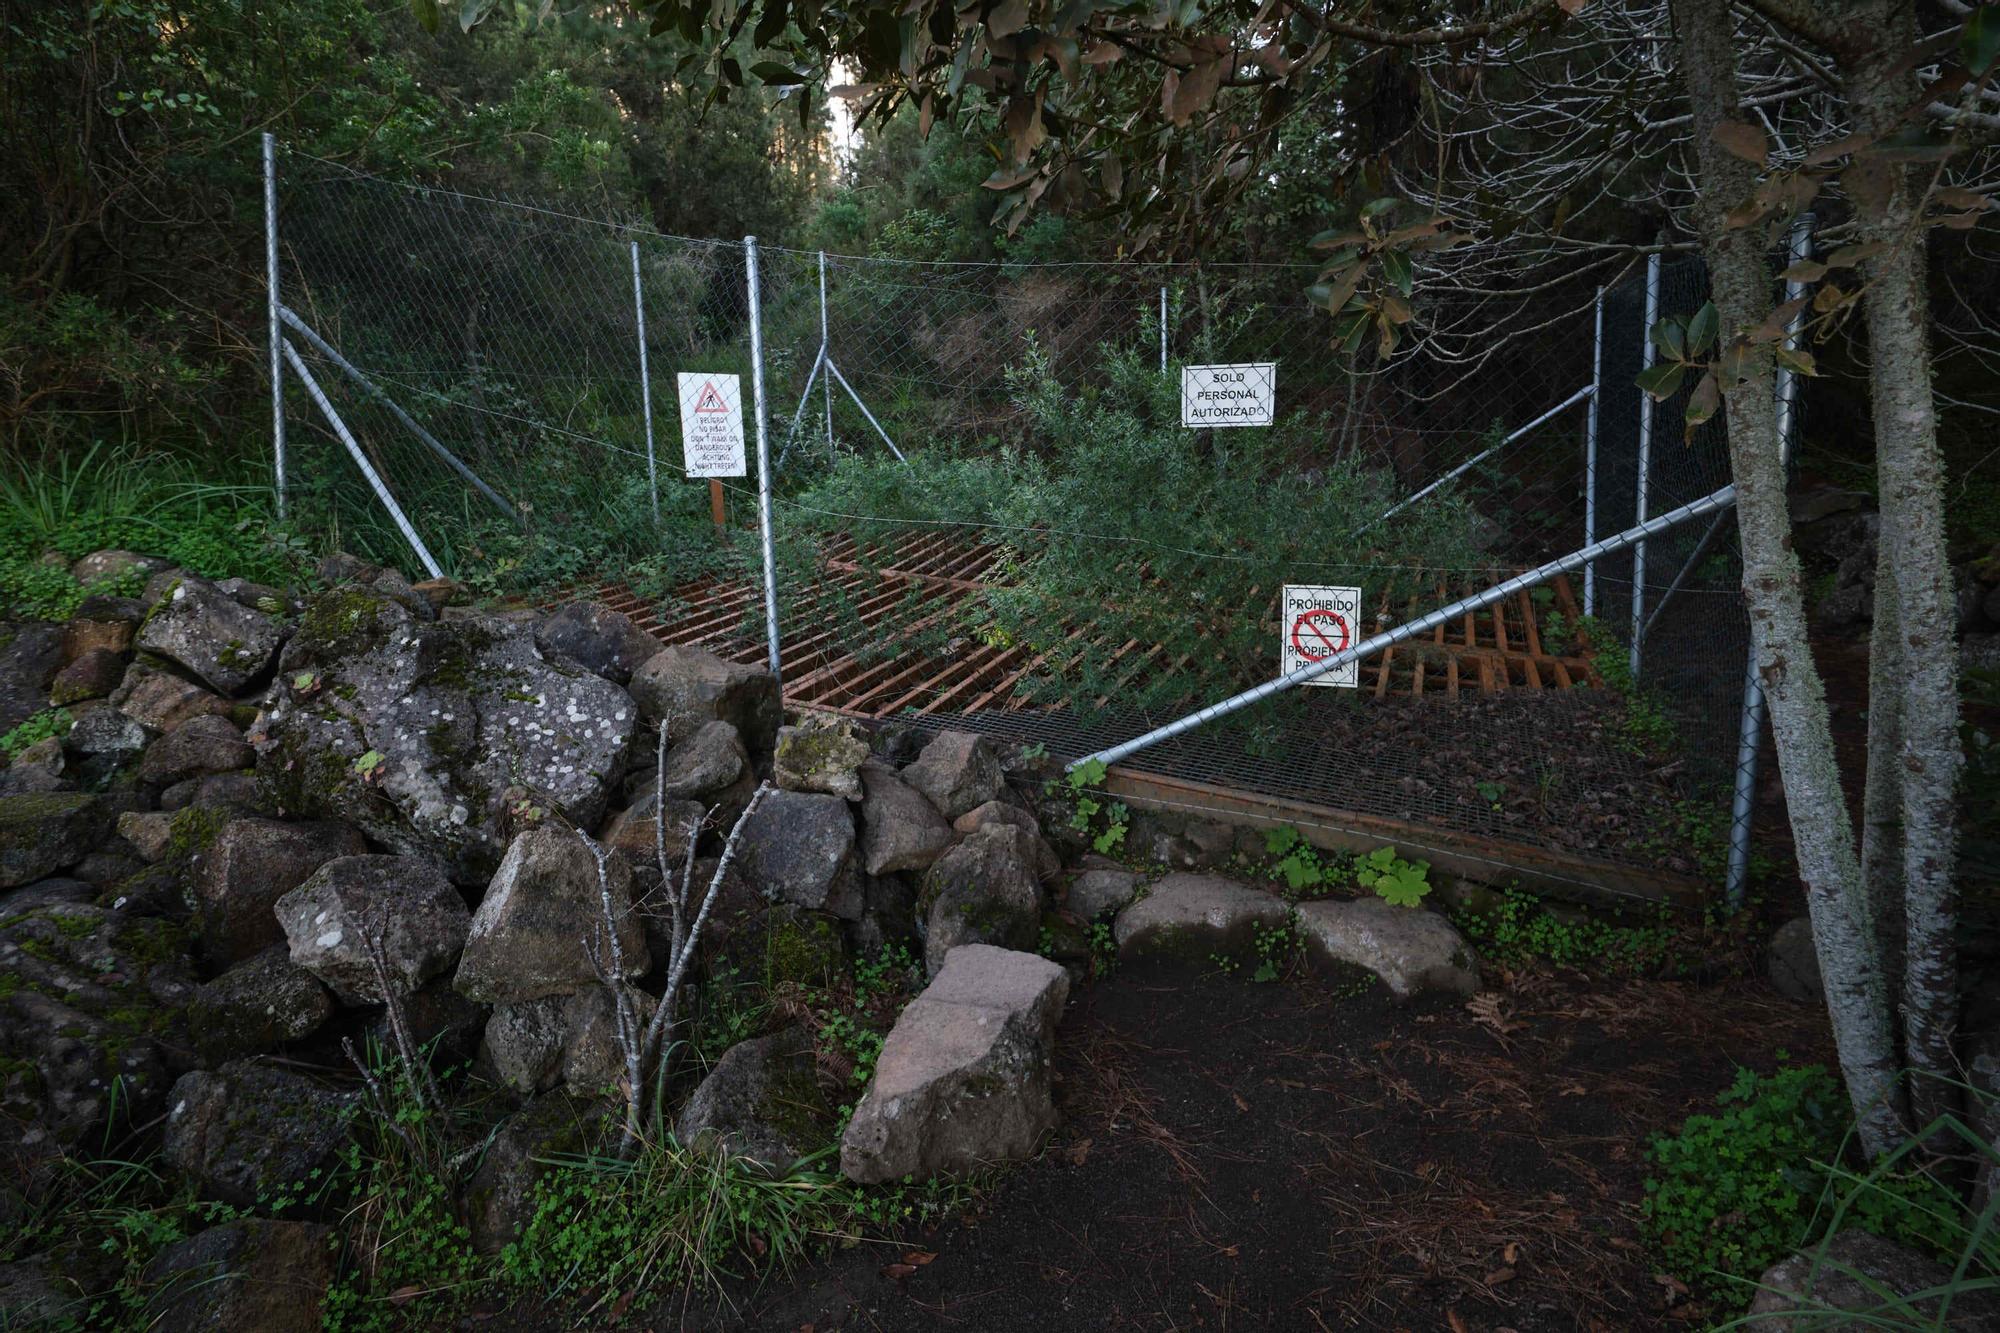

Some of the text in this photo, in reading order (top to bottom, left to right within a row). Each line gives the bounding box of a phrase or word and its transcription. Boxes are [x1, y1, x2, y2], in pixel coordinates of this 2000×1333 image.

[1213, 373, 1245, 383] SOLO
[1197, 390, 1260, 400] PERSONAL
[1191, 406, 1265, 417] AUTORIZADO
[1289, 598, 1354, 611] PROHIBIDO
[1296, 614, 1345, 626] EL PASO
